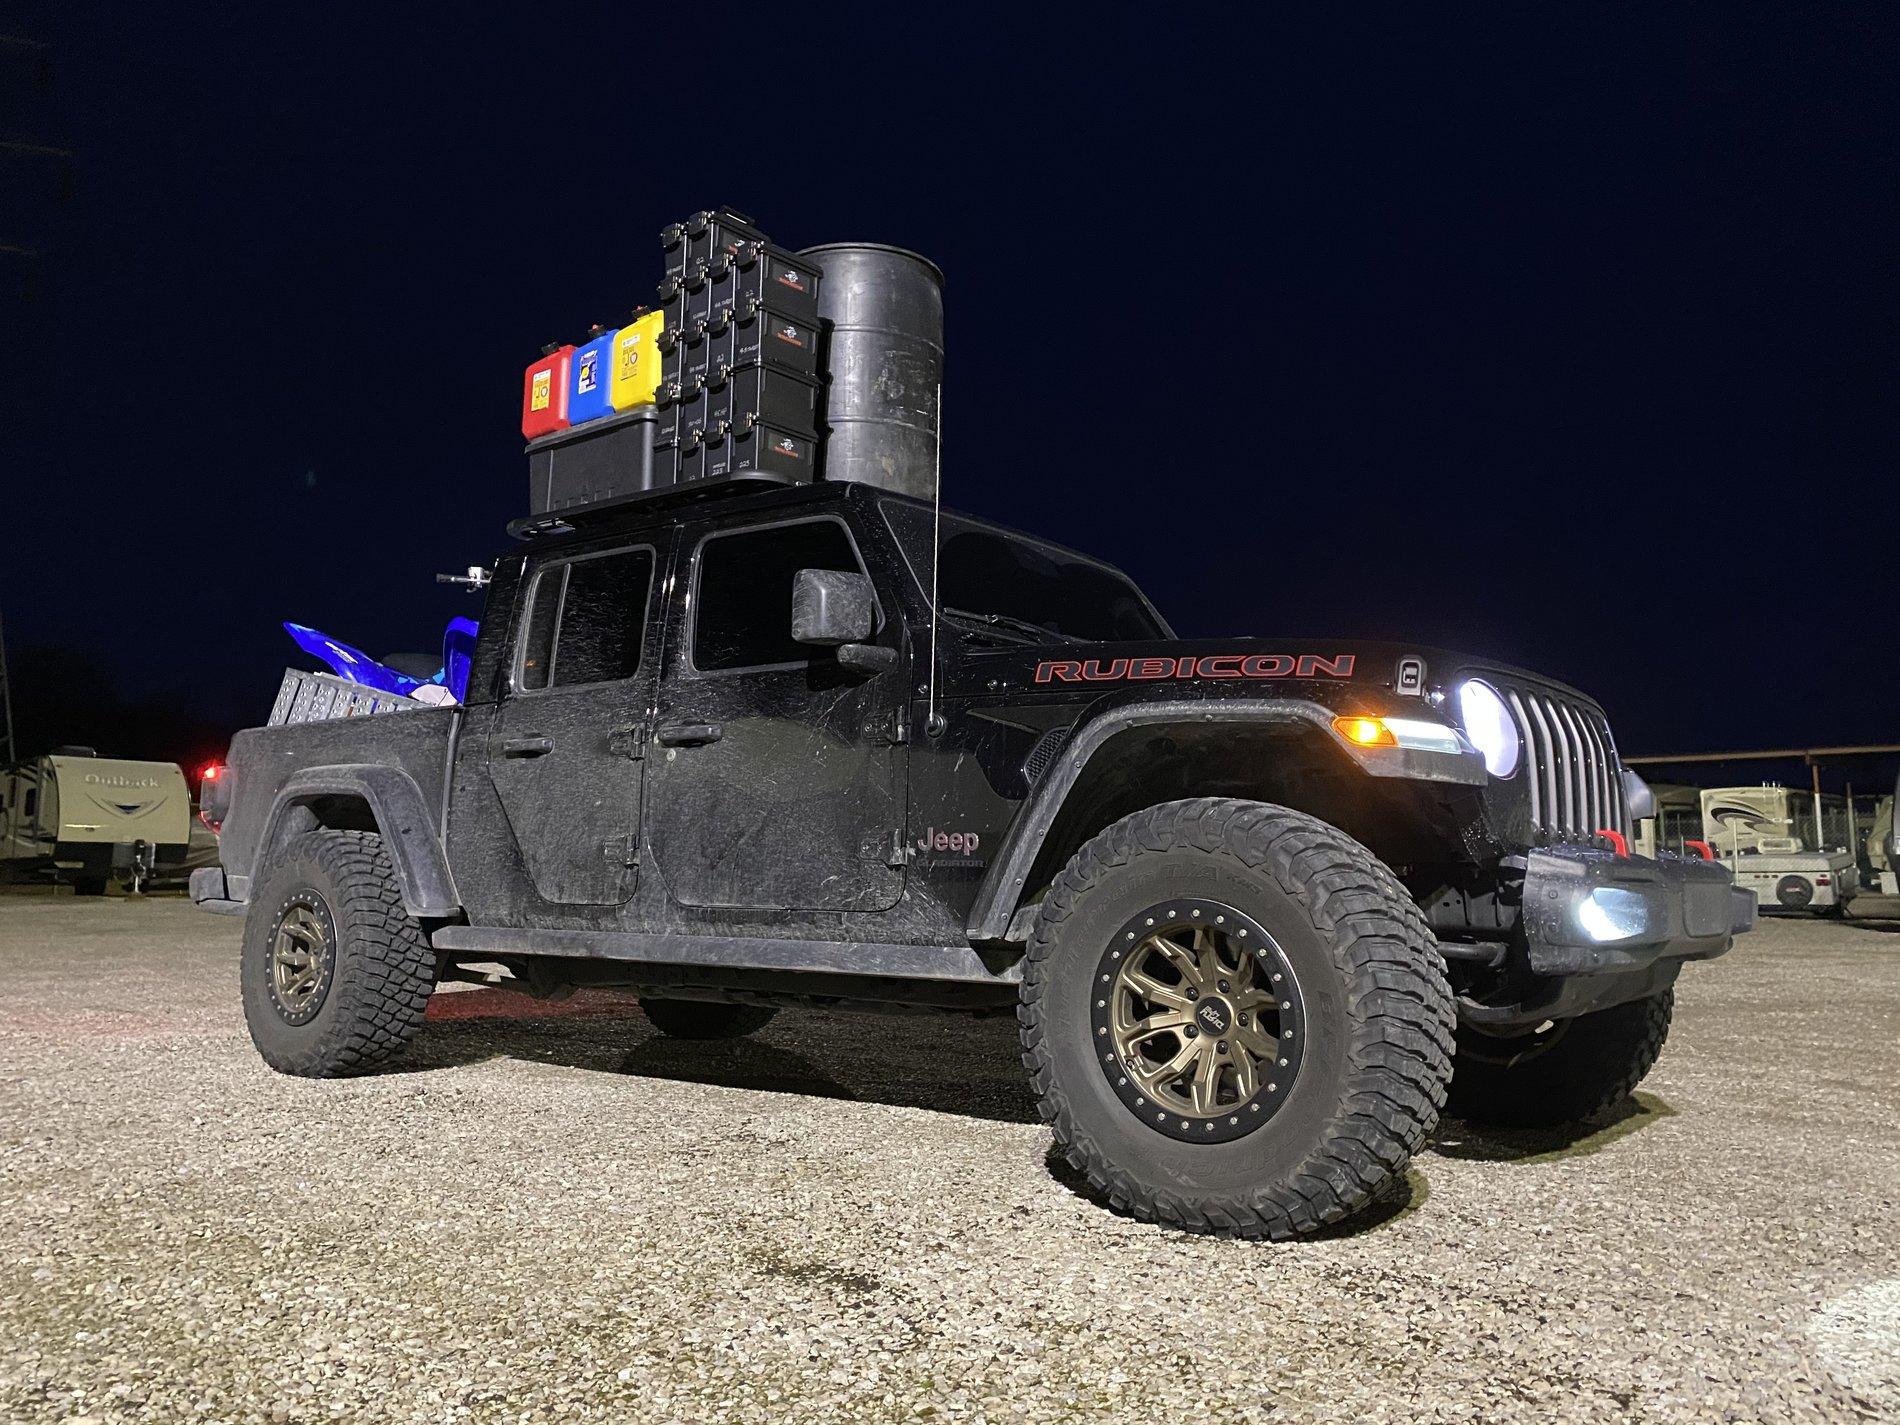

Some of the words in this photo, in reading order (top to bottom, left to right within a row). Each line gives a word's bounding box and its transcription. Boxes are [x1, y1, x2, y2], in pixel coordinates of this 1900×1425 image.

[1035, 655, 1355, 683] RUBICON
[84, 773, 160, 788] Outback
[917, 826, 980, 857] Jeep
